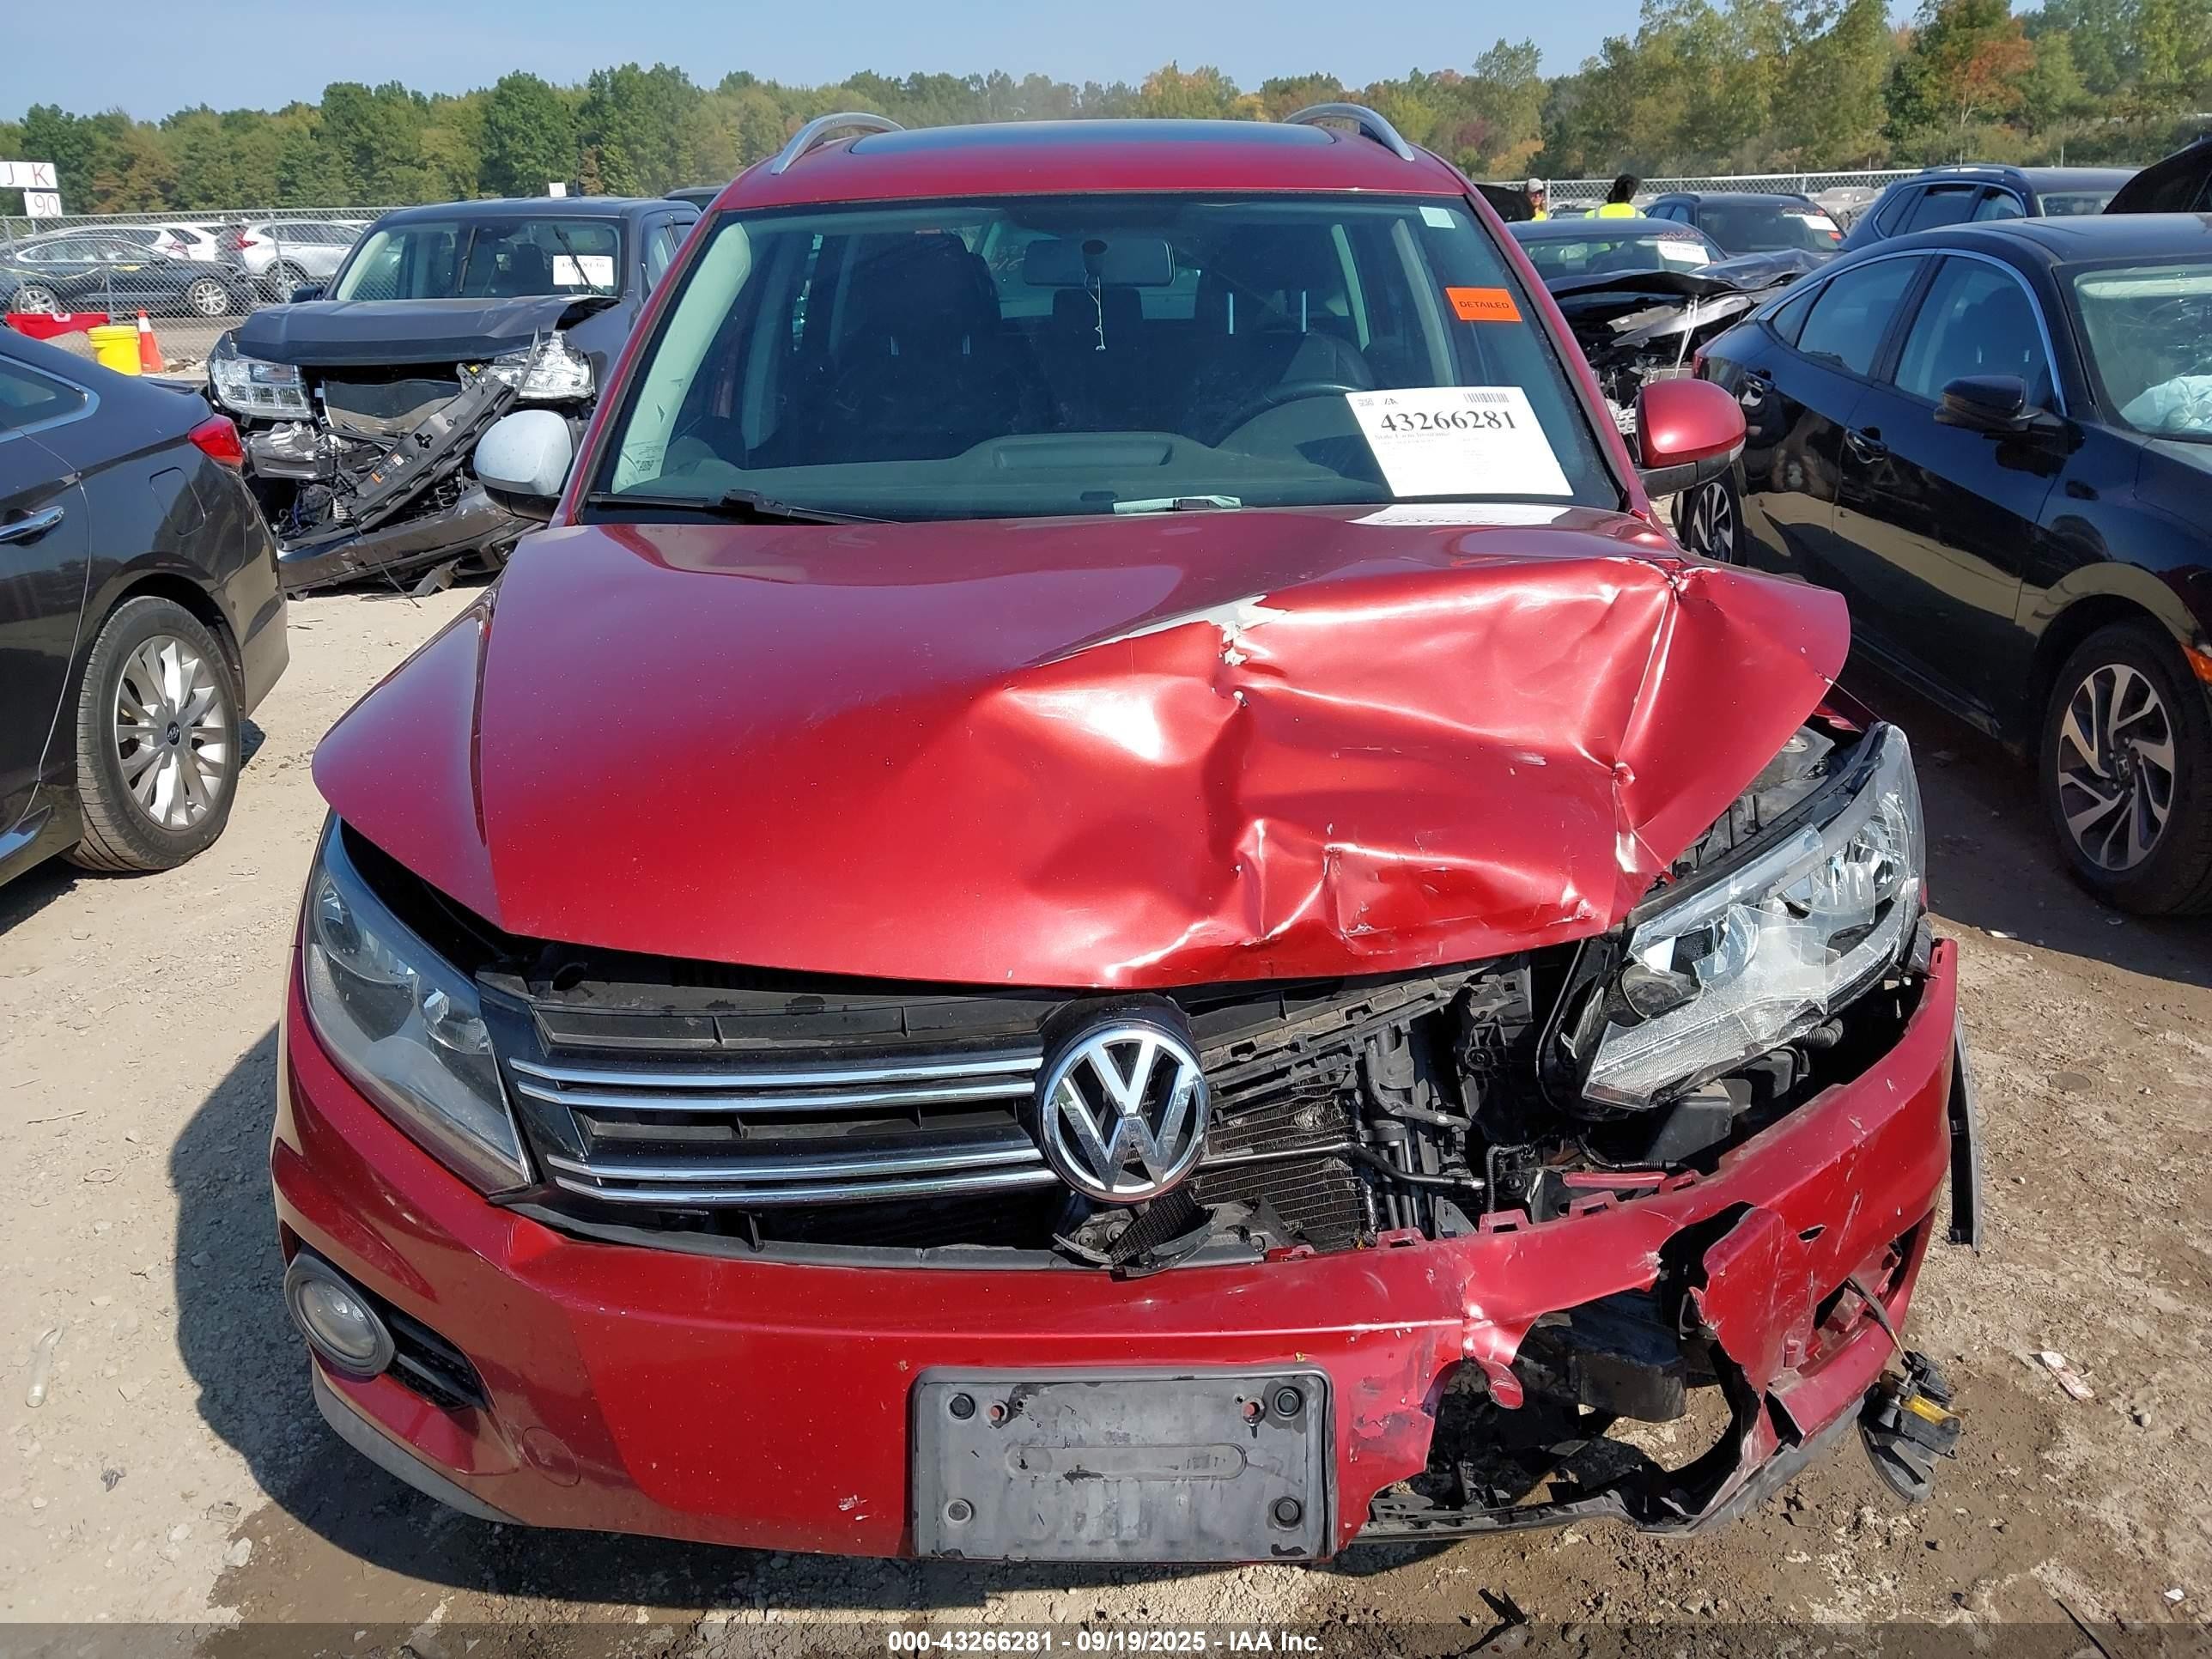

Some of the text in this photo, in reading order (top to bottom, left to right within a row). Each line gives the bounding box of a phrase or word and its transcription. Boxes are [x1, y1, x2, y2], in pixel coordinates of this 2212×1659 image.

[7, 163, 50, 186] J K
[34, 194, 58, 216] 90
[1380, 410, 1516, 432] 43266281
